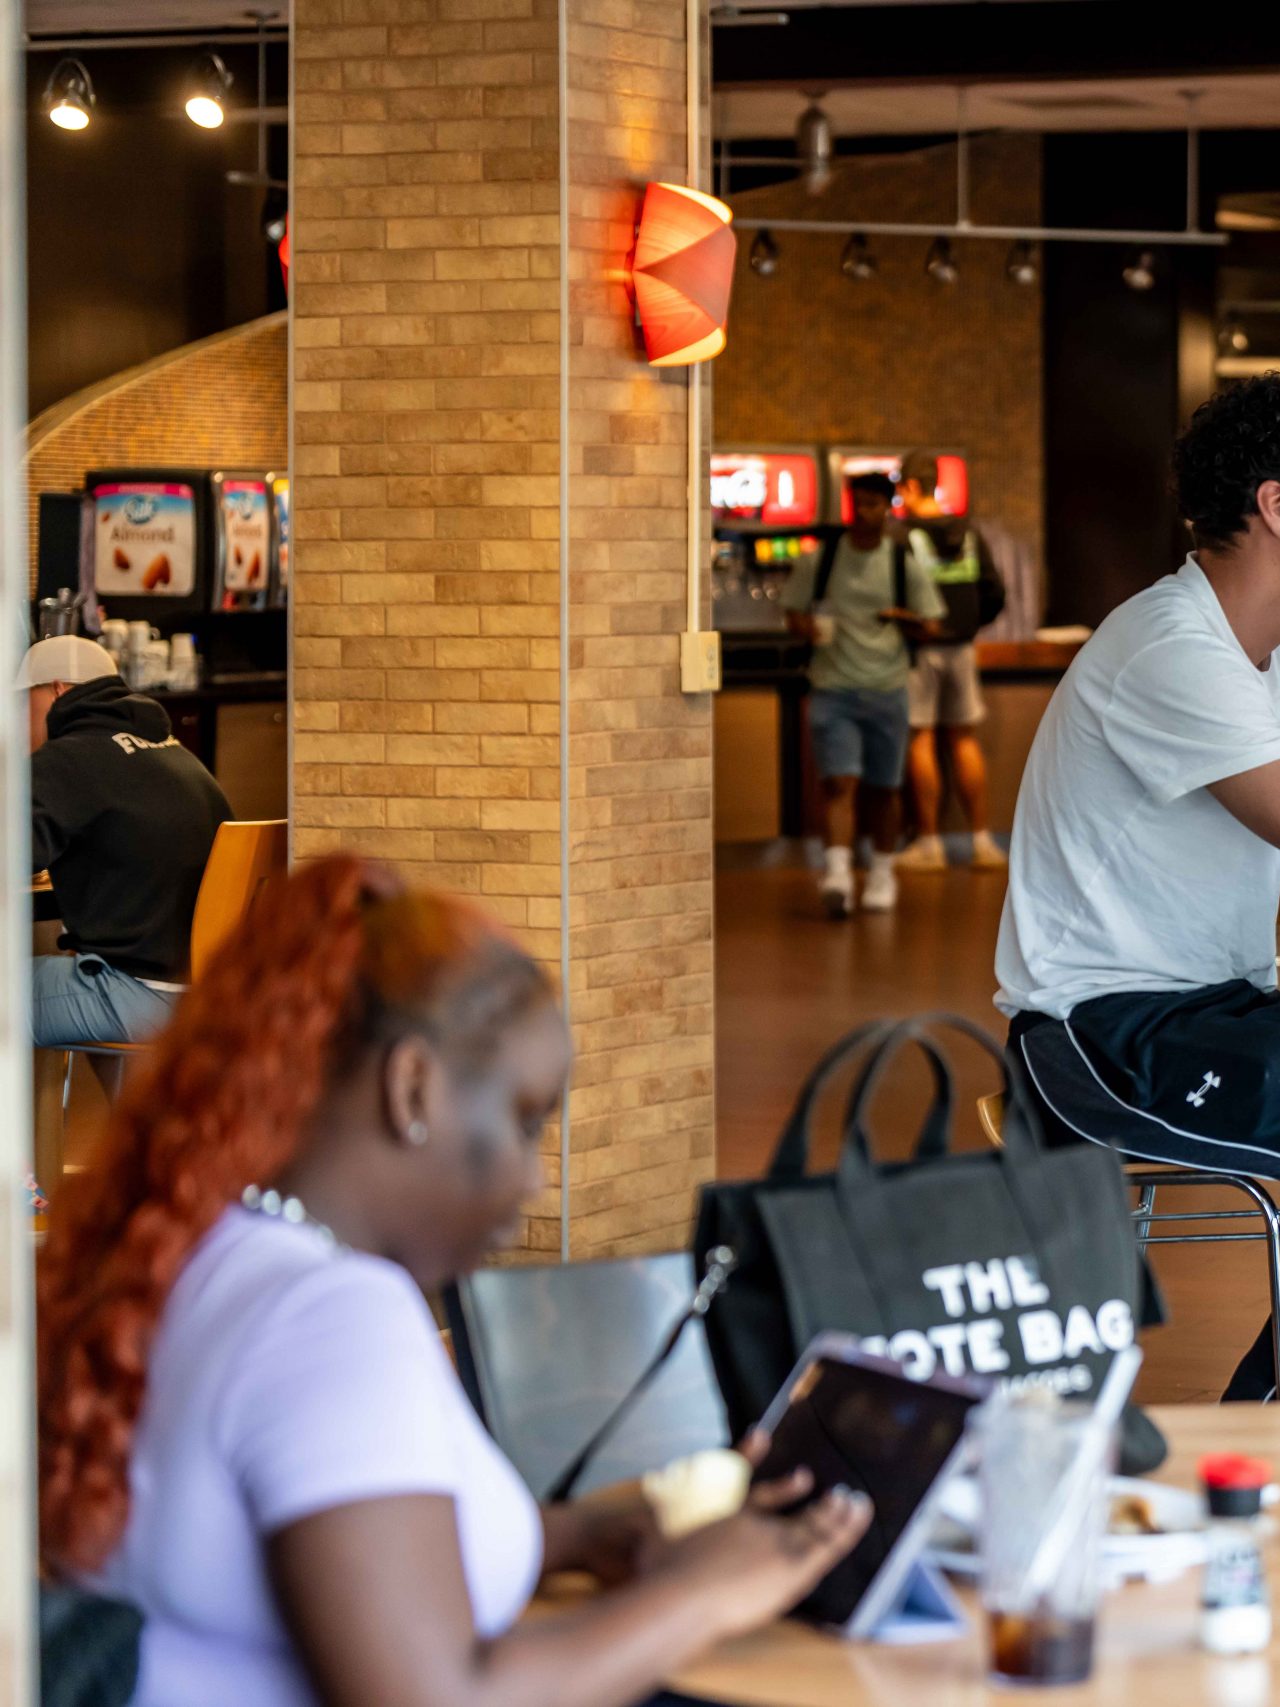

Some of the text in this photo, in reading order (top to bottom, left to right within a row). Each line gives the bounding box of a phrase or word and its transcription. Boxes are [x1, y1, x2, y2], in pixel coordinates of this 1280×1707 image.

[111, 526, 175, 543] Almond
[922, 1255, 1049, 1318] THE
[1017, 1299, 1134, 1364] BAG
